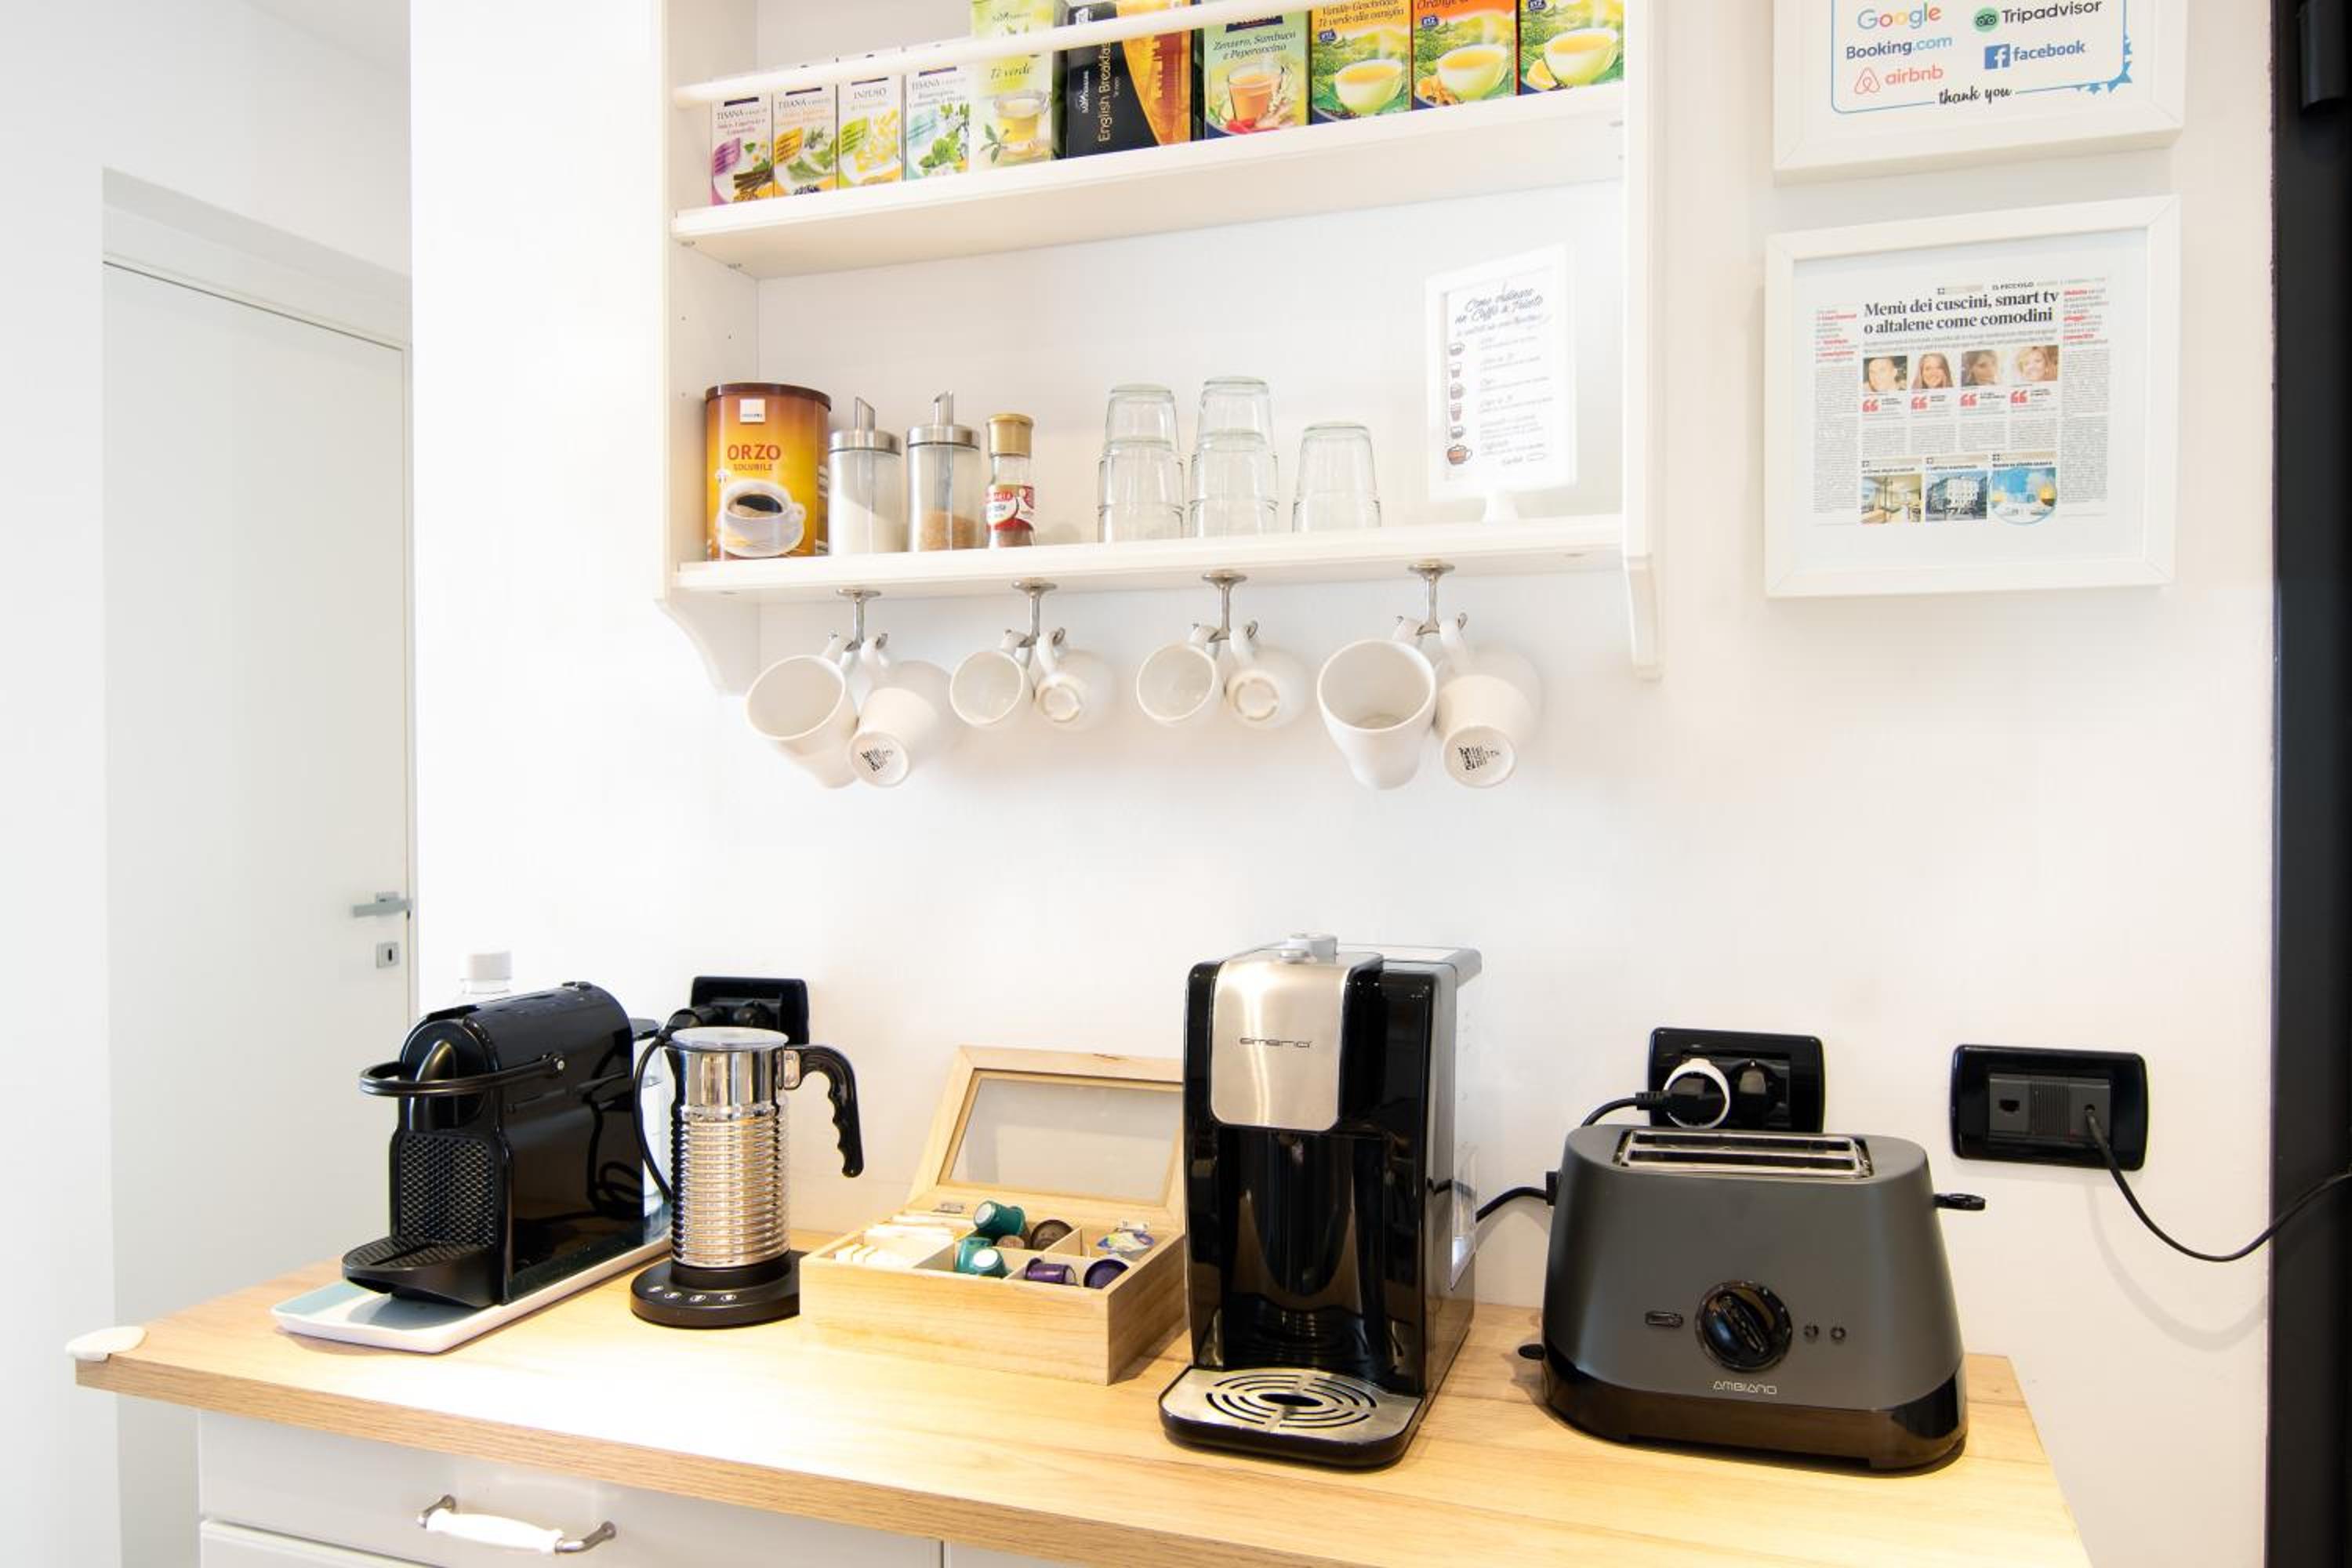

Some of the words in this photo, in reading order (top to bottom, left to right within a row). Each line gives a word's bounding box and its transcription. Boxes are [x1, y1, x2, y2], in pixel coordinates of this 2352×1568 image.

[1857, 2, 1941, 30] Google
[2002, 1, 2103, 24] Tripadvisor
[1846, 37, 1952, 60] Booking.com
[2013, 41, 2085, 62] facebook
[1098, 42, 1111, 93] Breakfas
[1885, 64, 1944, 85] airbnb
[1939, 85, 1980, 105] thank
[1984, 88, 2013, 103] you
[1098, 96, 1112, 142] English
[1864, 301, 1906, 317] Menù
[1910, 299, 1933, 312] dei
[1936, 294, 1991, 311] cuscini,
[1995, 290, 2039, 306] smart
[2043, 291, 2060, 303] tv
[1864, 324, 1873, 334] o
[1875, 318, 1933, 333] altalene
[1936, 317, 1976, 328] come
[1980, 307, 2053, 325] comodini
[727, 444, 782, 461] ORZO
[1712, 1381, 1777, 1395] AMBIANO
